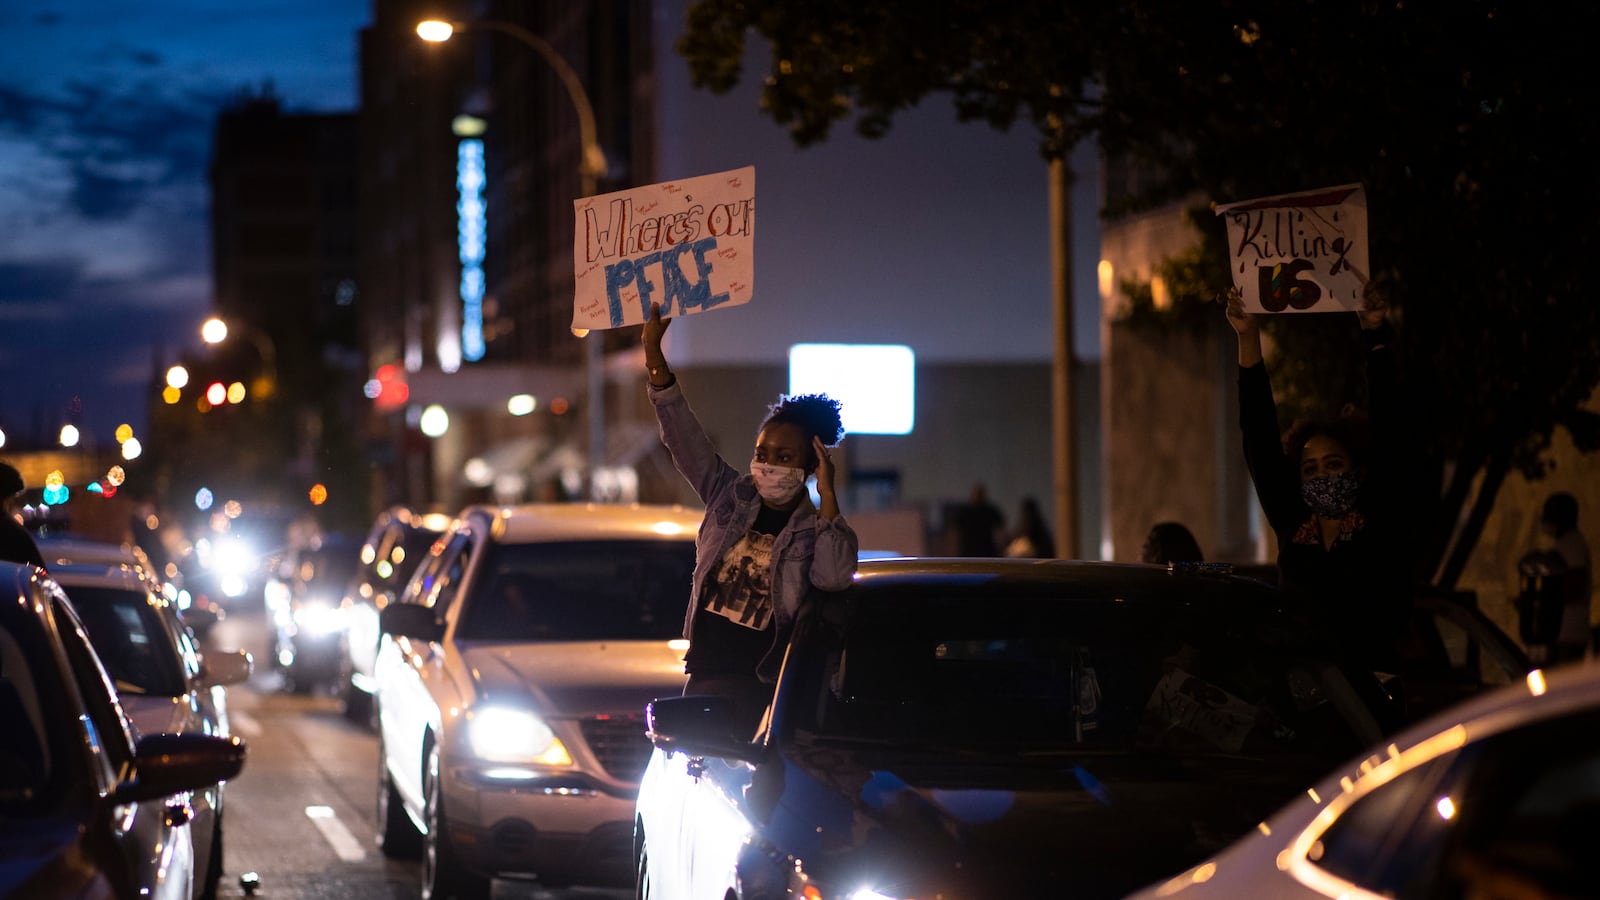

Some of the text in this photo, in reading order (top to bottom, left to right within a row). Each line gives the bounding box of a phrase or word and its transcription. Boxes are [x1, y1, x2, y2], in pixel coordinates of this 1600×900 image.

[585, 195, 704, 263] Where's
[1227, 211, 1353, 276] Killing
[604, 236, 731, 328] PEACE
[1258, 259, 1322, 312] US
